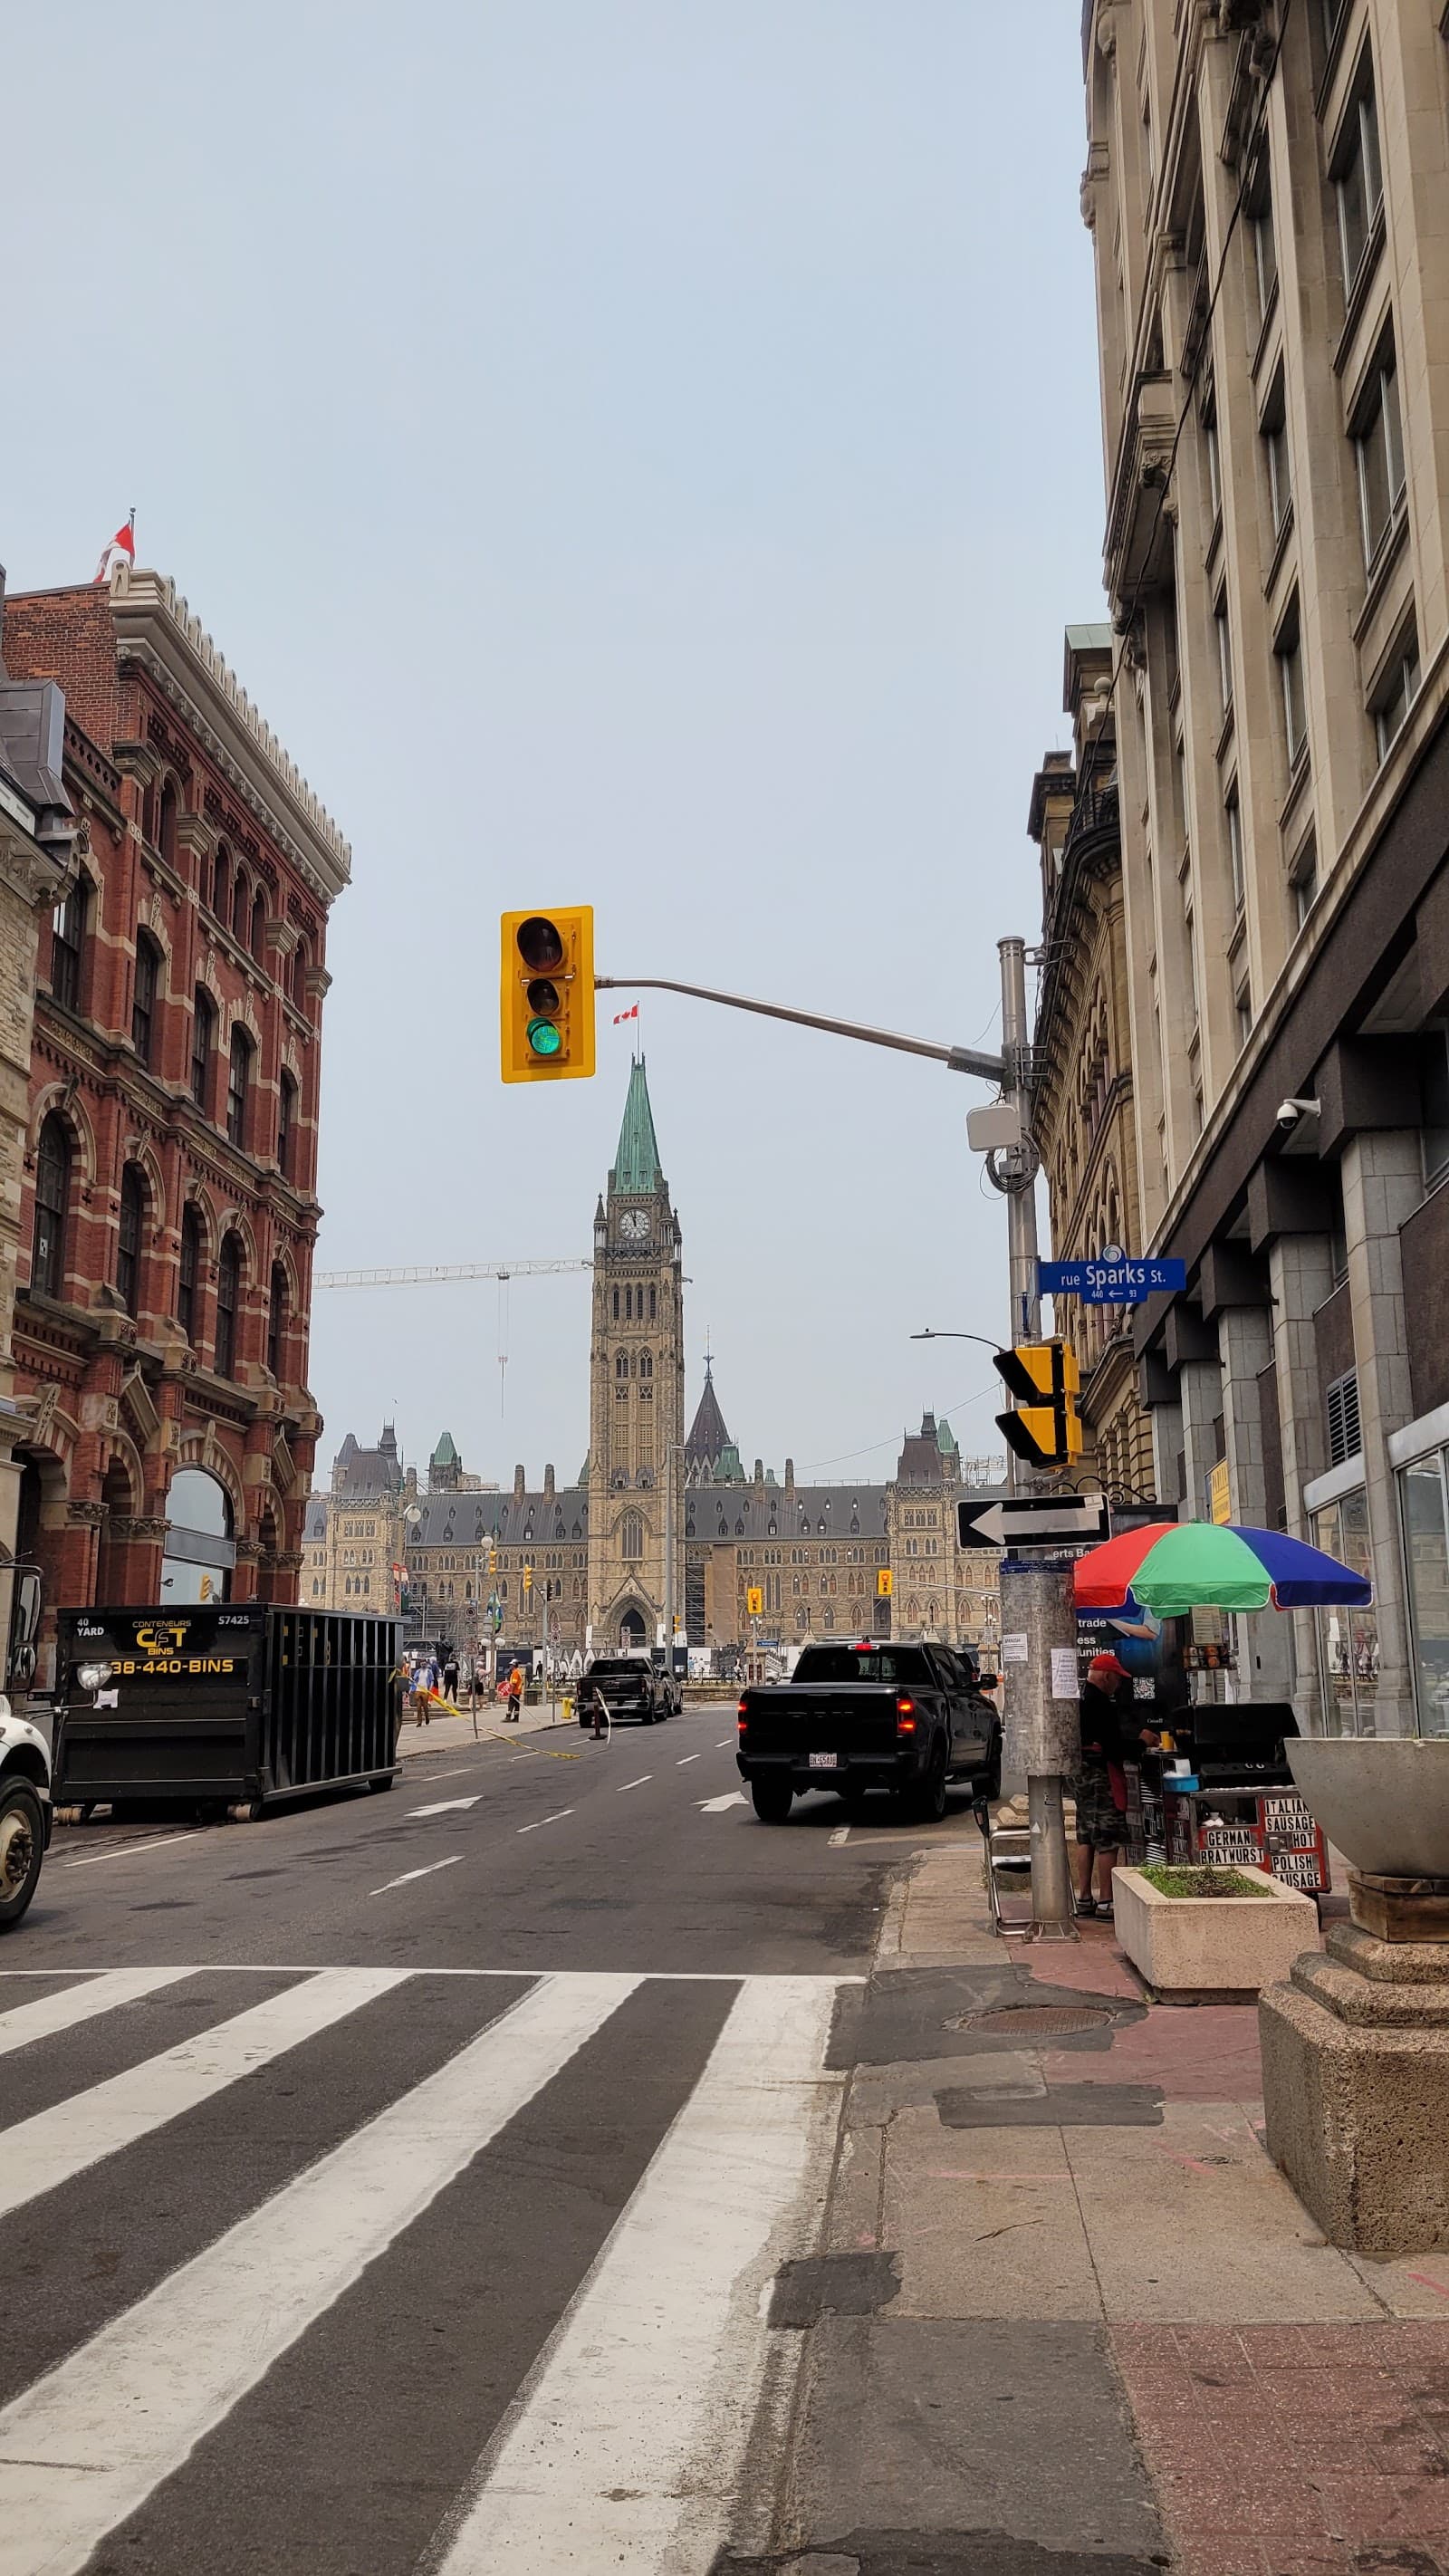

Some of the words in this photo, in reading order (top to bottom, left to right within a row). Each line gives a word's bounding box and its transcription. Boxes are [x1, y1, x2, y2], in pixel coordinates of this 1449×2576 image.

[1060, 1274, 1080, 1286] rue
[1086, 1263, 1146, 1290] Sparks
[1150, 1270, 1166, 1283] St.
[1091, 1290, 1104, 1299] 440
[1129, 1289, 1137, 1298] 93
[1053, 1549, 1074, 1559] erts
[77, 1618, 89, 1626] 40
[132, 1620, 192, 1629] CONTENEURS
[218, 1616, 250, 1625] S7425
[1078, 1619, 1107, 1628] trade
[77, 1627, 104, 1636] YARD
[1077, 1637, 1097, 1645] ess
[148, 1648, 174, 1656] BINS
[1077, 1647, 1116, 1658] unities
[110, 1659, 234, 1675] 38-440-BINS
[1267, 1816, 1315, 1831] SAUSAGE
[1208, 1830, 1251, 1847] GERMAN
[1293, 1832, 1314, 1848] HOT
[1201, 1848, 1264, 1865] BRATWURST
[1273, 1856, 1312, 1871] POLISH
